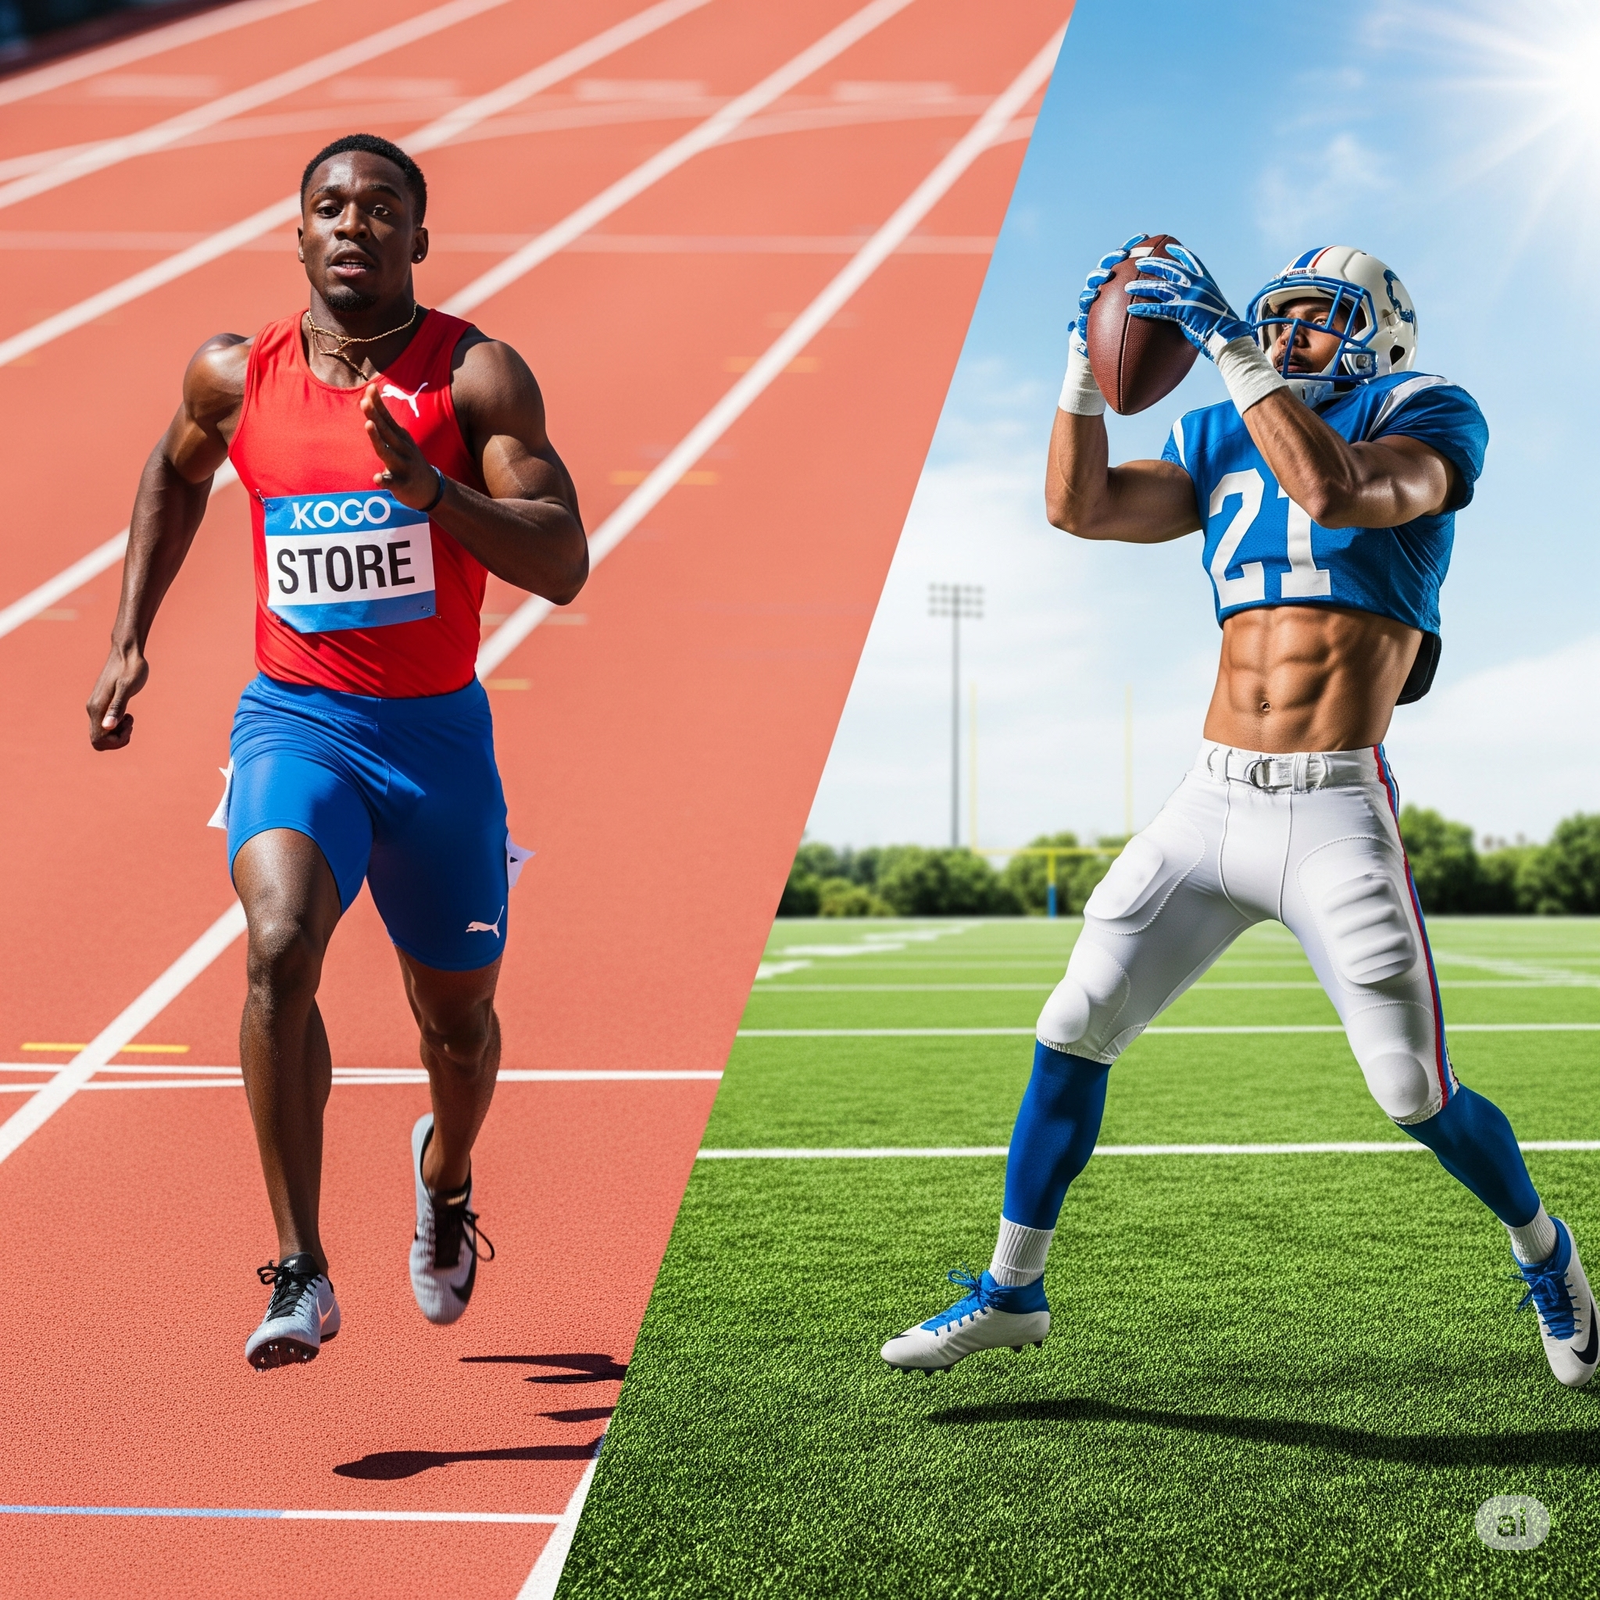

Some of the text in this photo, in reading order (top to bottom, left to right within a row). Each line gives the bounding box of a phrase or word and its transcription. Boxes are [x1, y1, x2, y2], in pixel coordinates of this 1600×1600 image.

[290, 496, 391, 529] KOGO
[1209, 468, 1332, 609] 21
[277, 540, 415, 594] STORE
